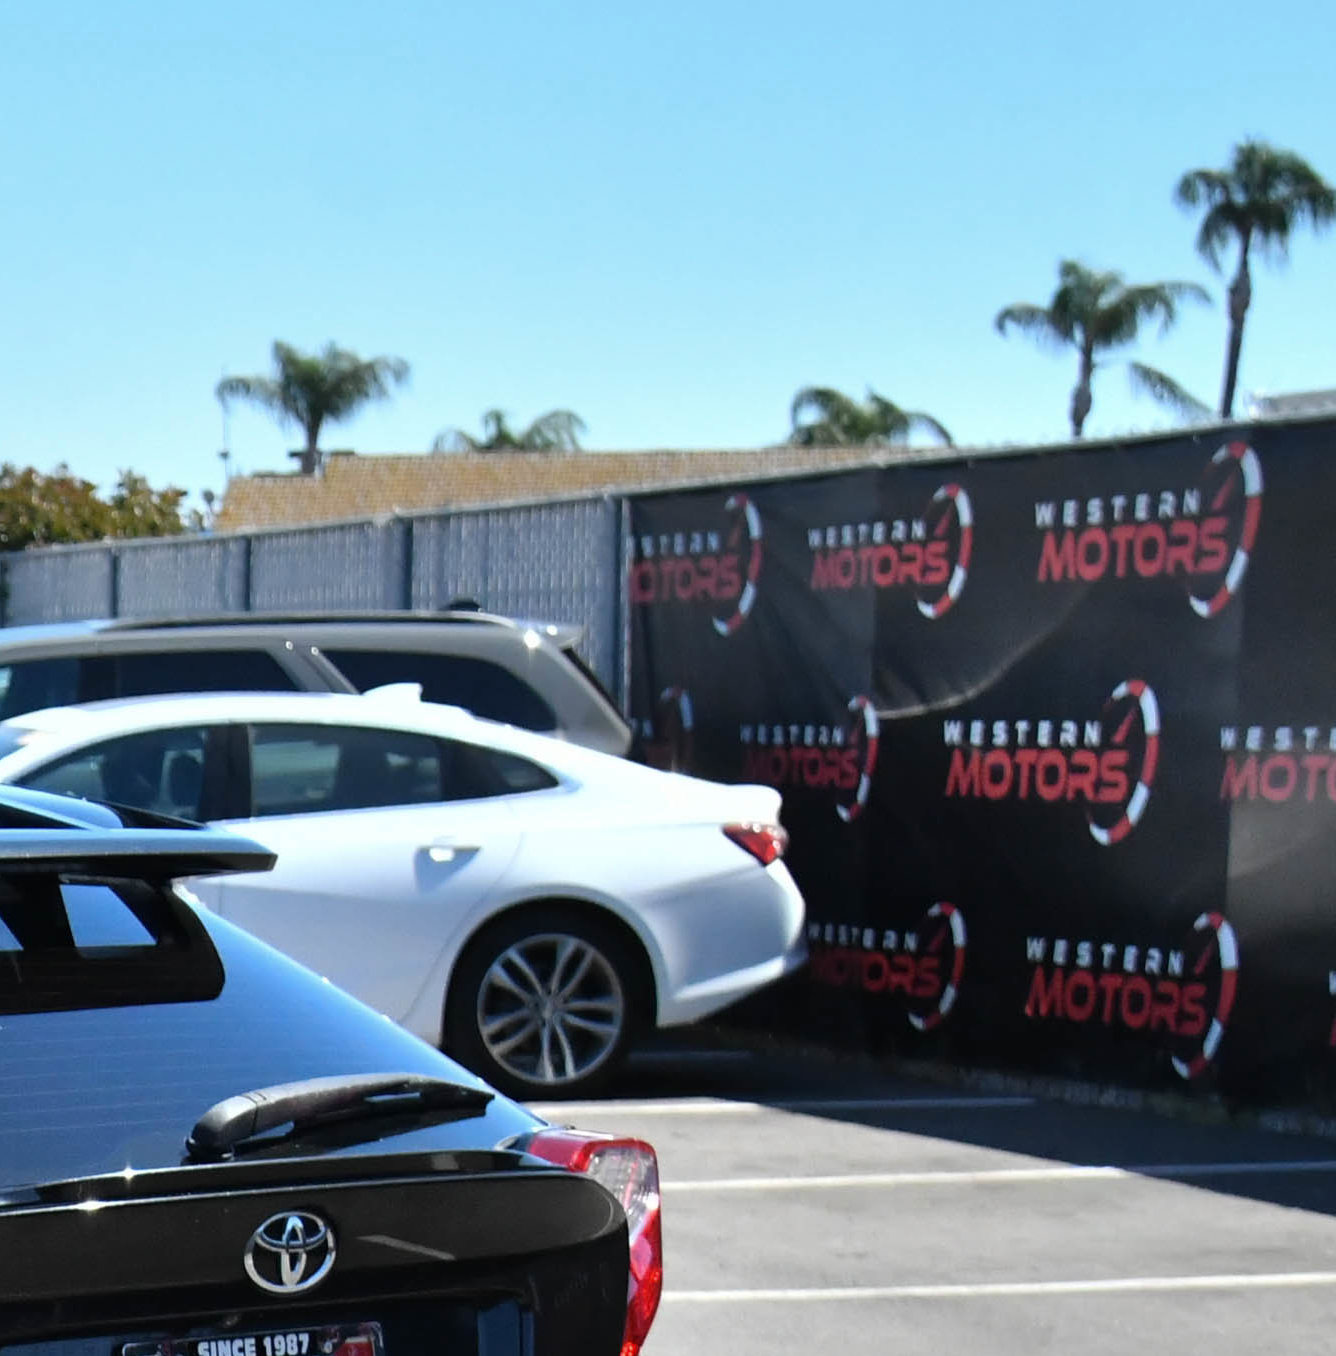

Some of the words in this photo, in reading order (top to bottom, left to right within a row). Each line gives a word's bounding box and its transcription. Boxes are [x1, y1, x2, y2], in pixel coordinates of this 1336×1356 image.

[1035, 488, 1202, 528] WESTERN
[808, 518, 926, 549] WESTERN
[1038, 517, 1229, 582] MOTORS
[811, 540, 949, 590] MOTORS
[740, 724, 845, 747] WESTERN
[943, 719, 1102, 748] WESTERN
[945, 748, 1129, 803] MOTORS
[1219, 754, 1336, 804] MOT
[1027, 936, 1185, 978] WESTERN
[1025, 964, 1207, 1036] MOTORS
